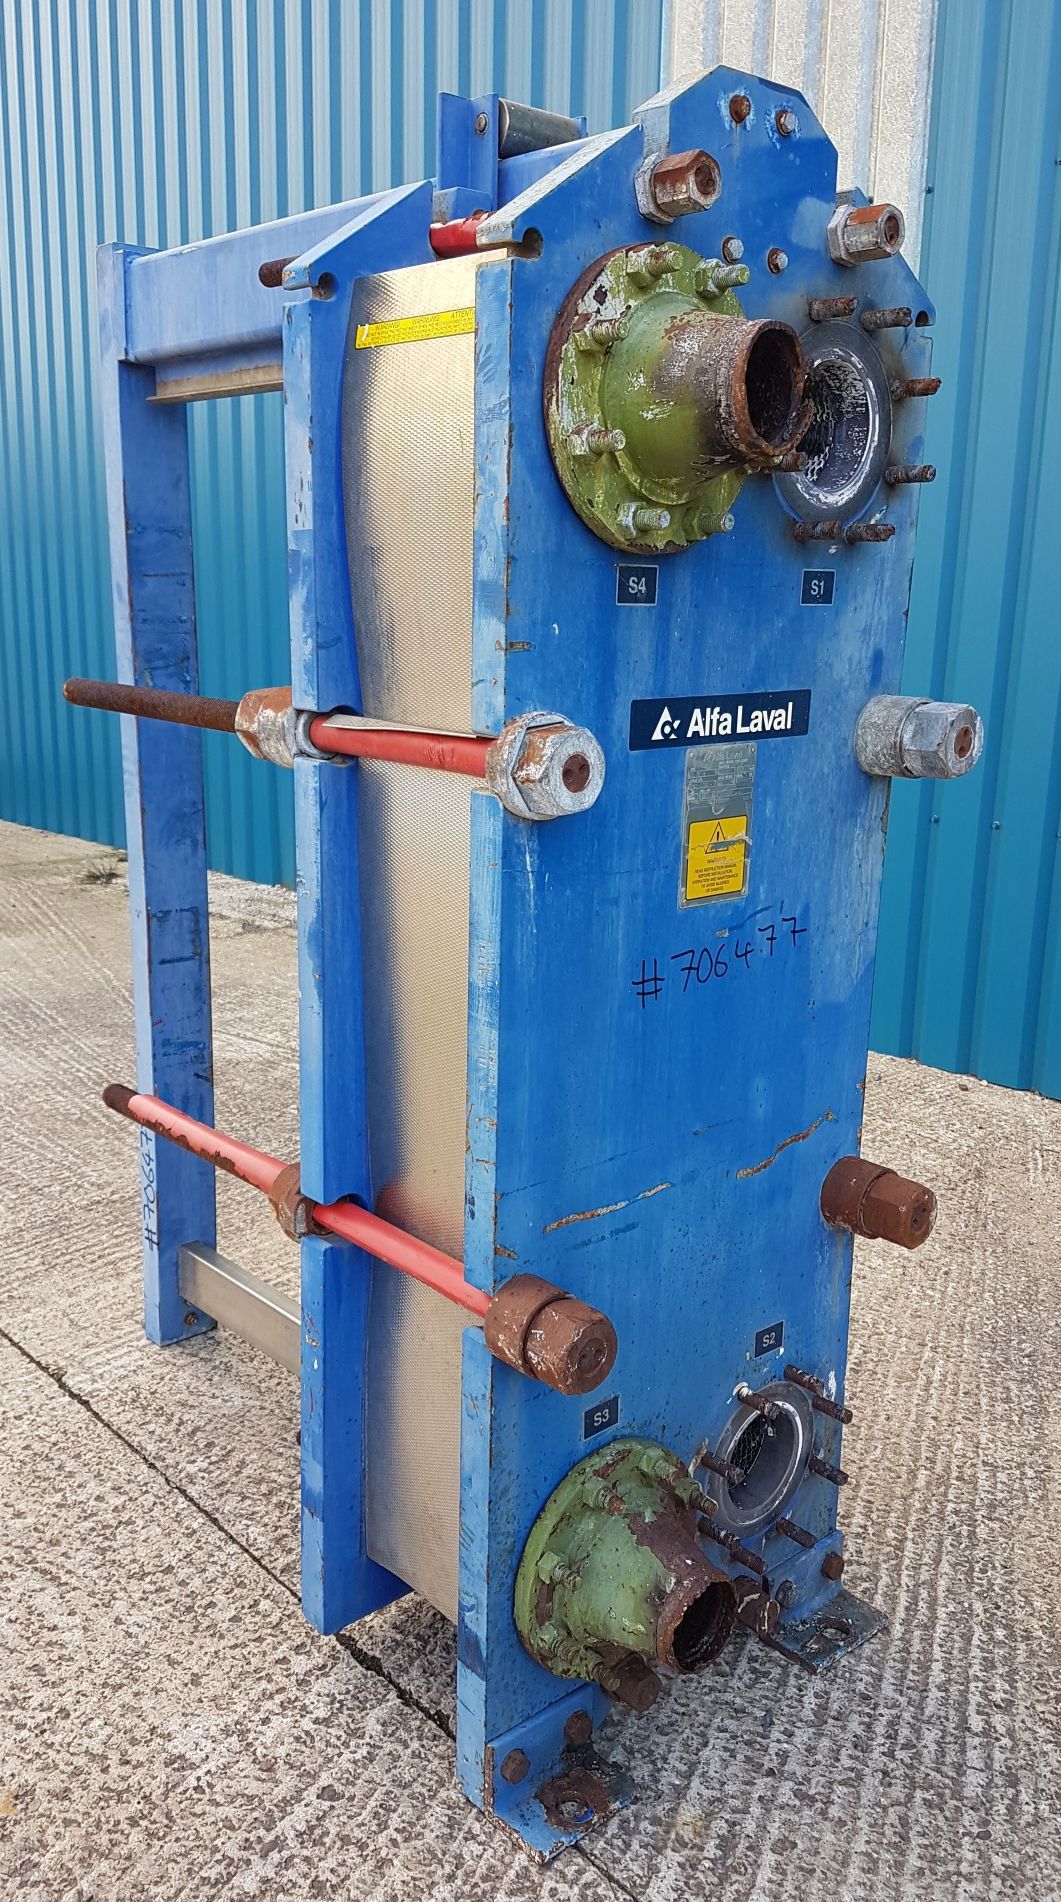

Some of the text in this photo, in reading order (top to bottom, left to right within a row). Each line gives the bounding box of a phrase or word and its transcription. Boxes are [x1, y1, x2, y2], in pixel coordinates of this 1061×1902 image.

[628, 576, 647, 594] S4
[810, 579, 825, 596] S1
[686, 701, 793, 738] Alfa Laval
[140, 1125, 159, 1252] #70647
[762, 1332, 776, 1348] S2
[593, 1408, 610, 1427] S3
